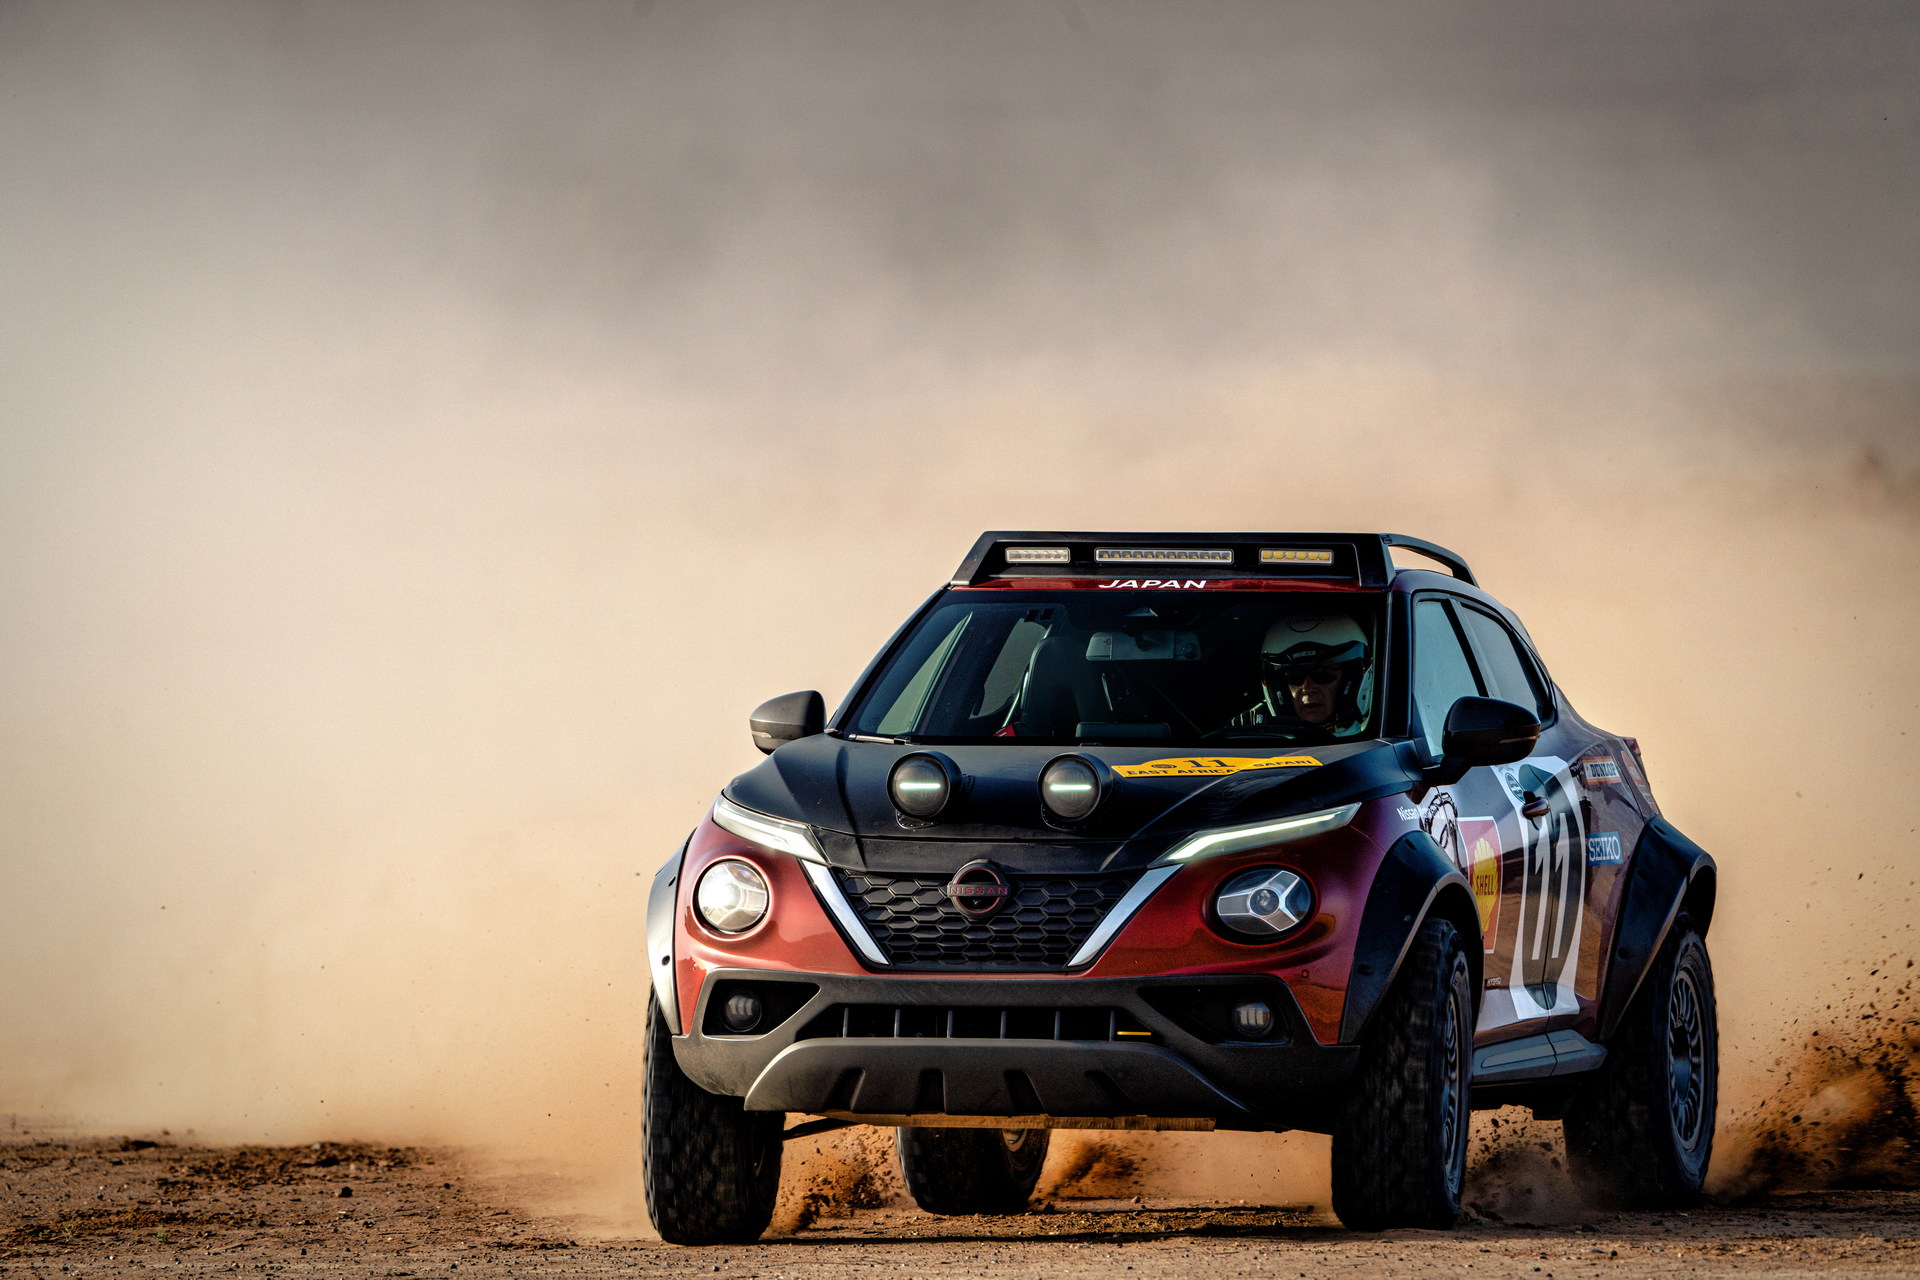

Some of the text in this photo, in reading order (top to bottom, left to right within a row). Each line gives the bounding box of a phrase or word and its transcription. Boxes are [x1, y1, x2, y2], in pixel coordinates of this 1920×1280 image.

[1098, 579, 1207, 589] JAPAN
[1183, 759, 1236, 768] 11
[1589, 762, 1617, 778] DUNLOP
[1588, 835, 1621, 862] SEIKO
[949, 886, 1008, 895] NISSAN
[1475, 874, 1495, 896] SHELL
[1532, 812, 1570, 960] 11
